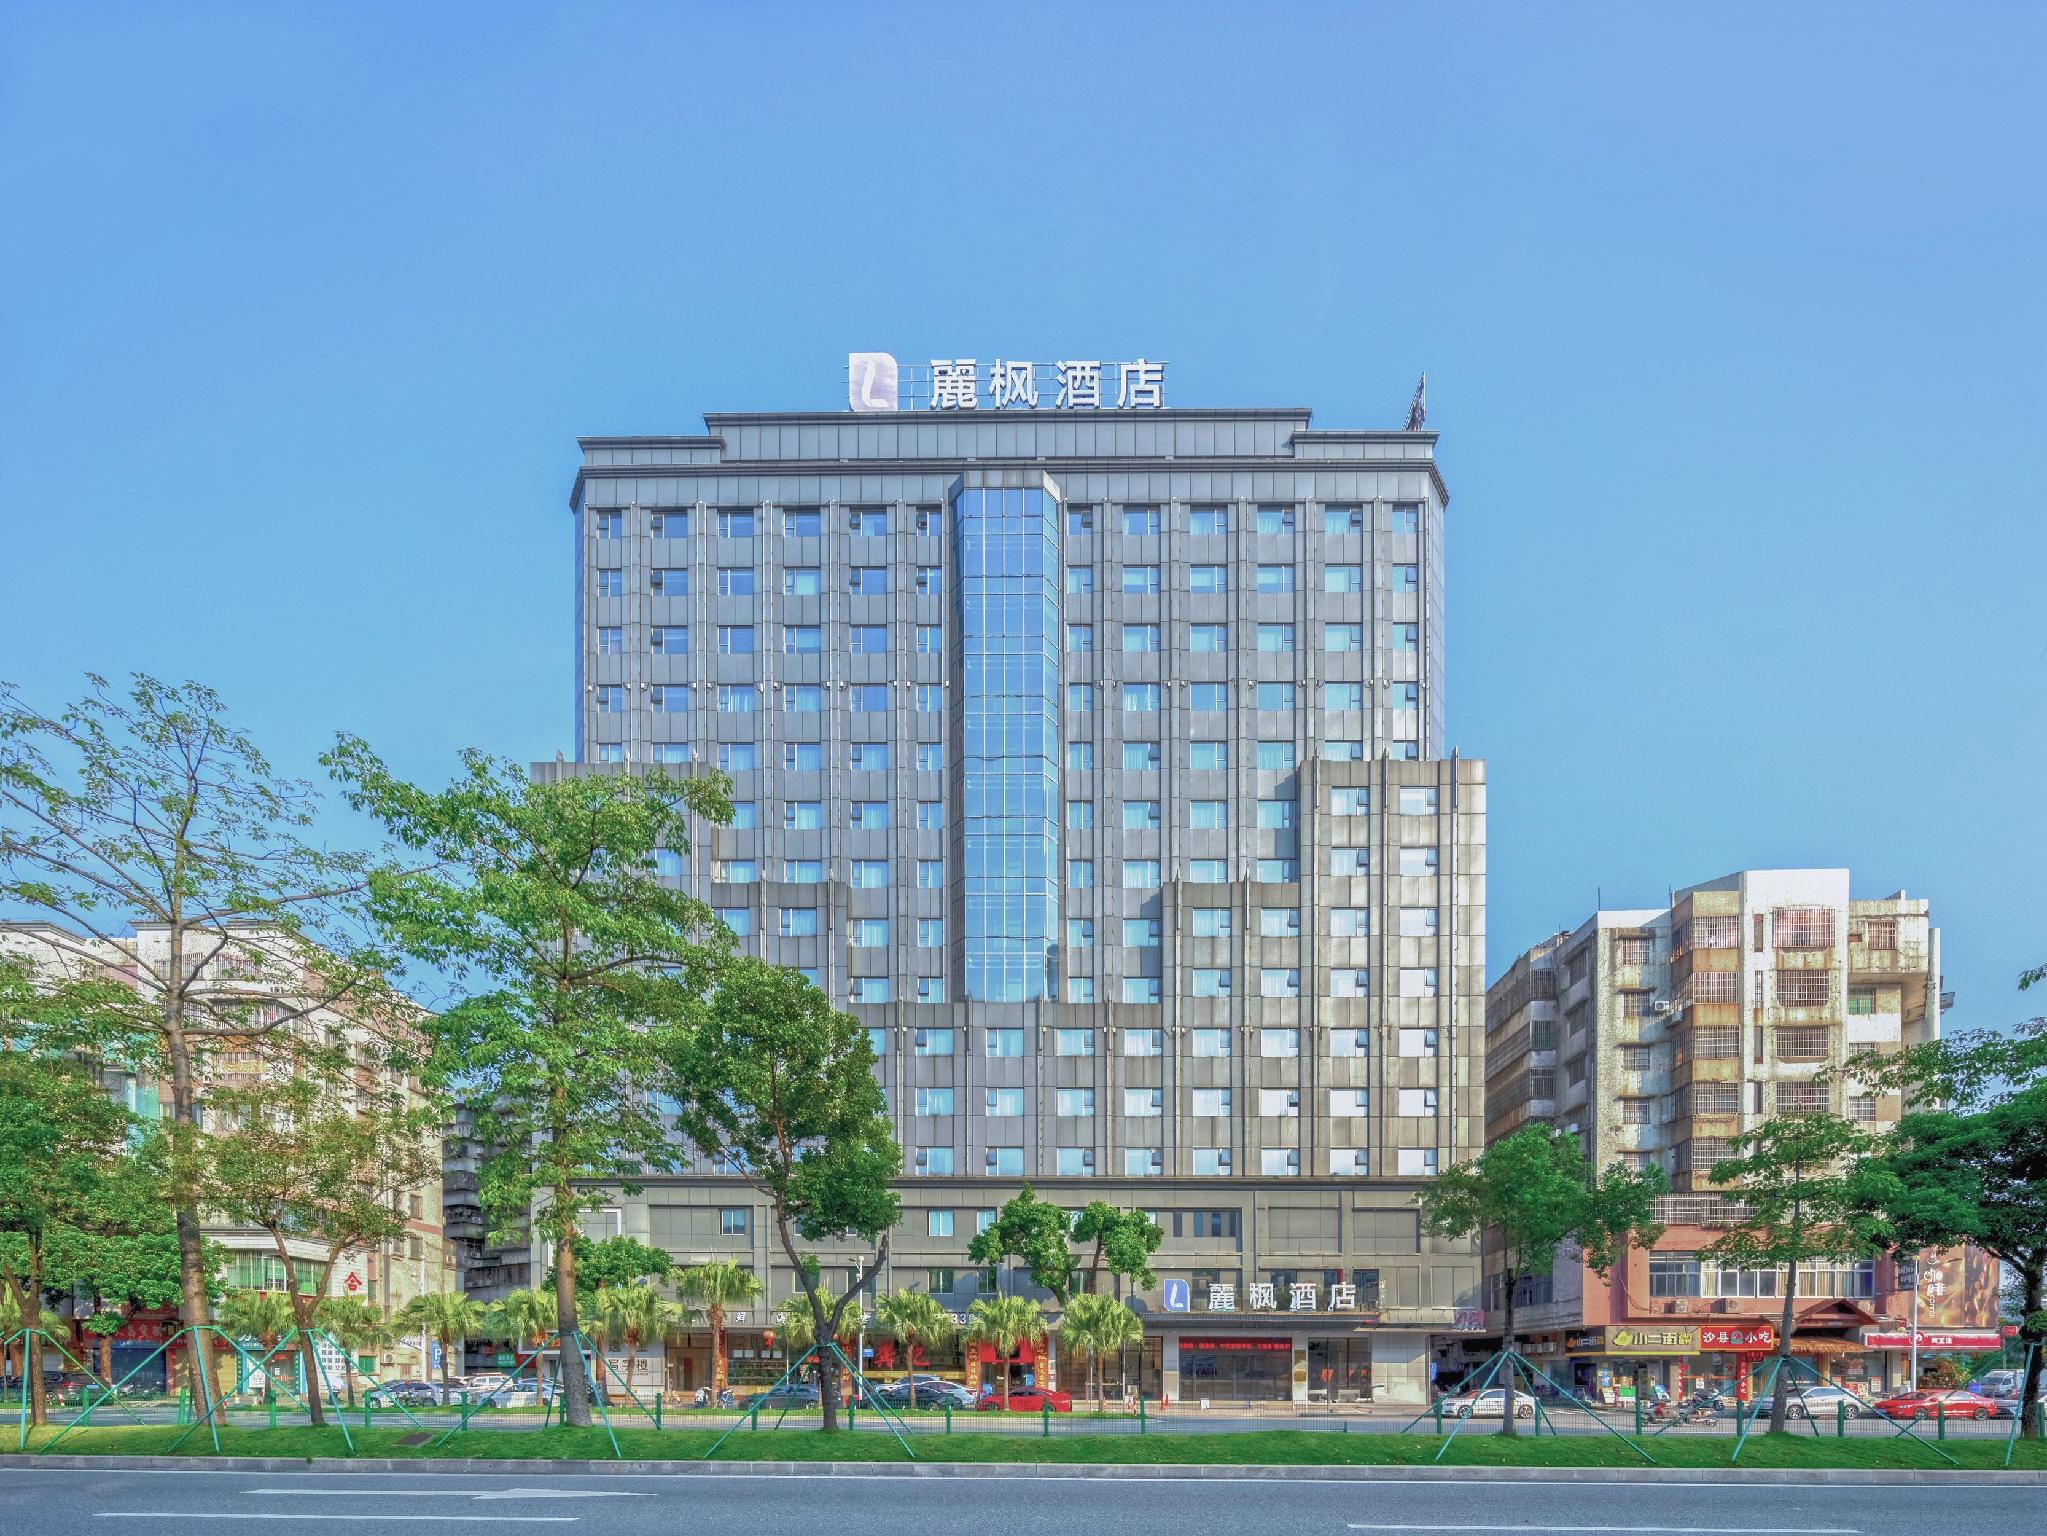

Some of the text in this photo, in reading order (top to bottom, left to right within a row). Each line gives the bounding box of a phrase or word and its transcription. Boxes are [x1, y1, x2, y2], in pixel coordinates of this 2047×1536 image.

[930, 358, 1164, 409] 麗枫酒店
[1208, 1281, 1356, 1312] 麗枫酒店
[1702, 1330, 1772, 1344] 沙县 小吃
[434, 1348, 442, 1360] P
